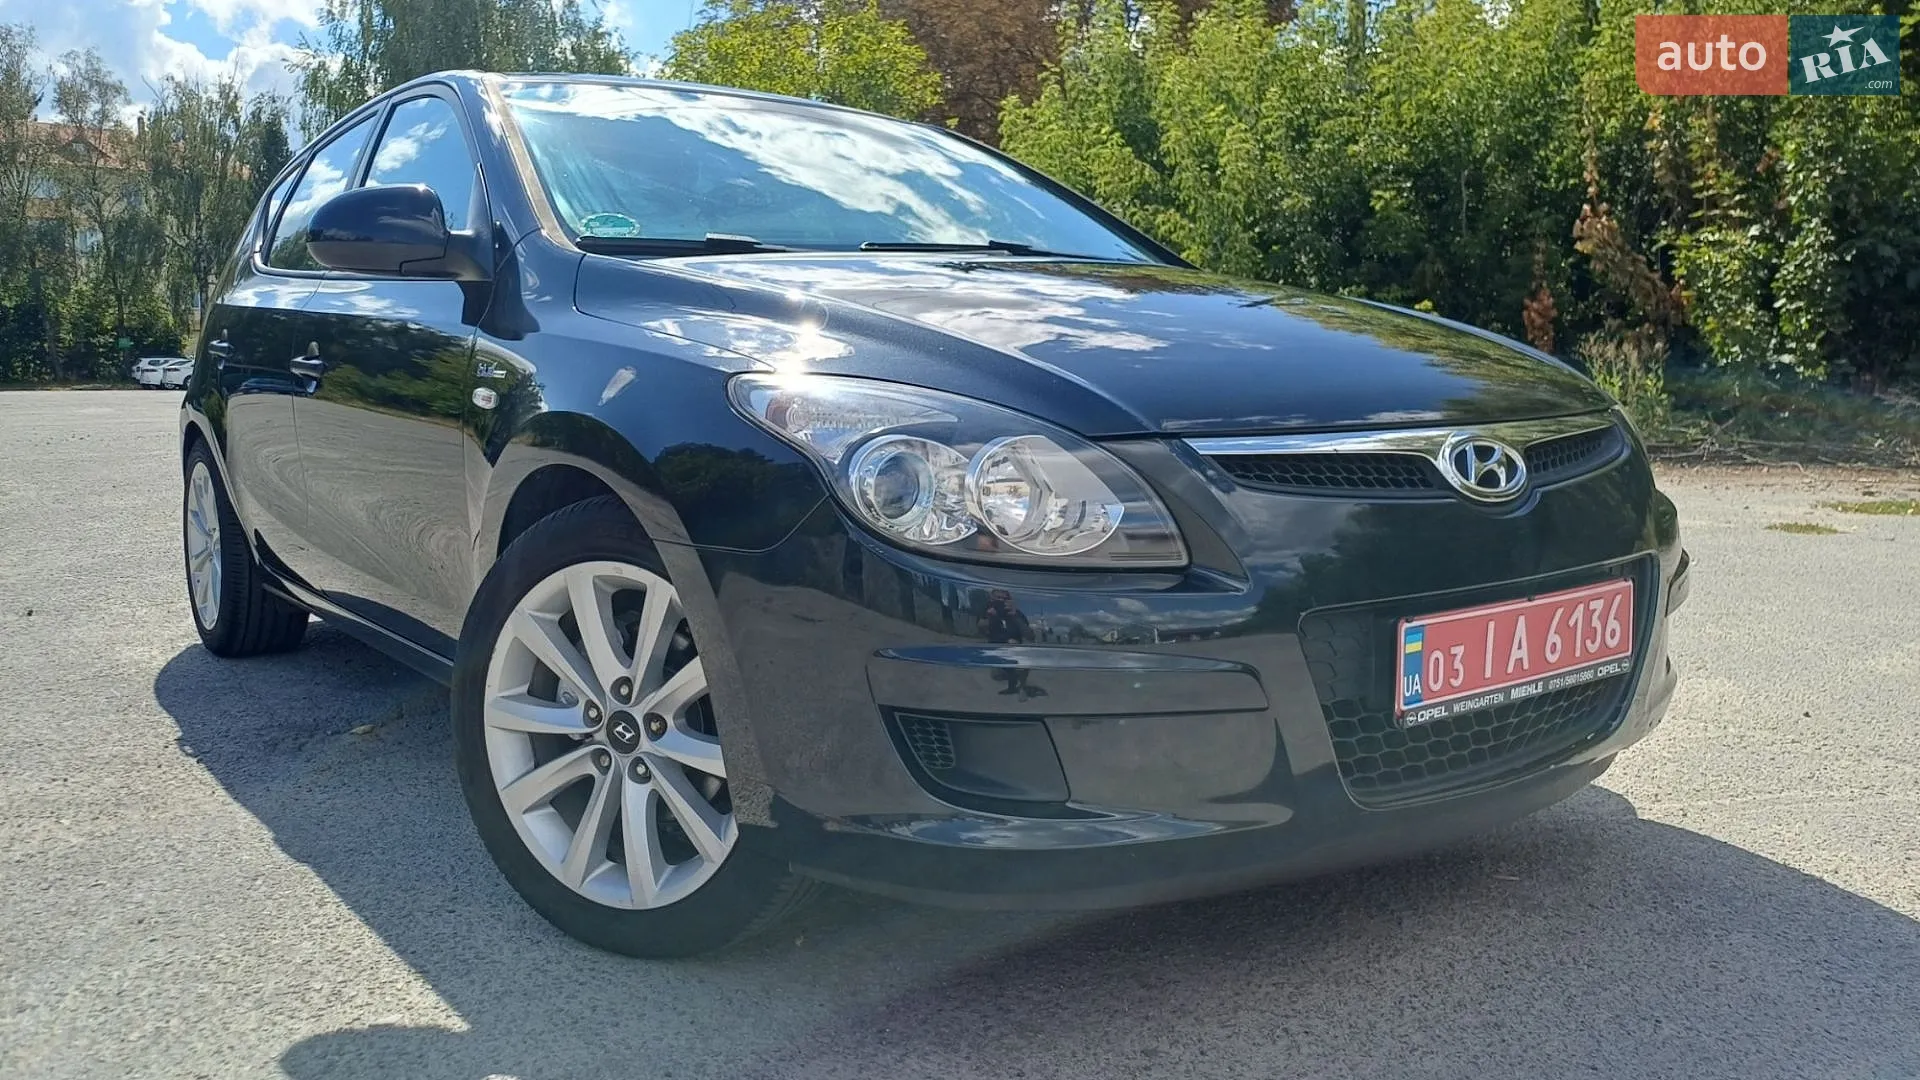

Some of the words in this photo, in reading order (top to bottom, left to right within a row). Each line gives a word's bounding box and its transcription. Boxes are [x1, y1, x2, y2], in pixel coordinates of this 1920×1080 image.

[1428, 644, 1465, 691] 03
[1544, 594, 1622, 664] 6136
[1404, 674, 1422, 697] UA
[1417, 706, 1449, 722] OPEL
[1453, 692, 1504, 713] WEINGARTEN
[1510, 681, 1543, 700] MIEHLE
[1597, 662, 1621, 677] OPEL
